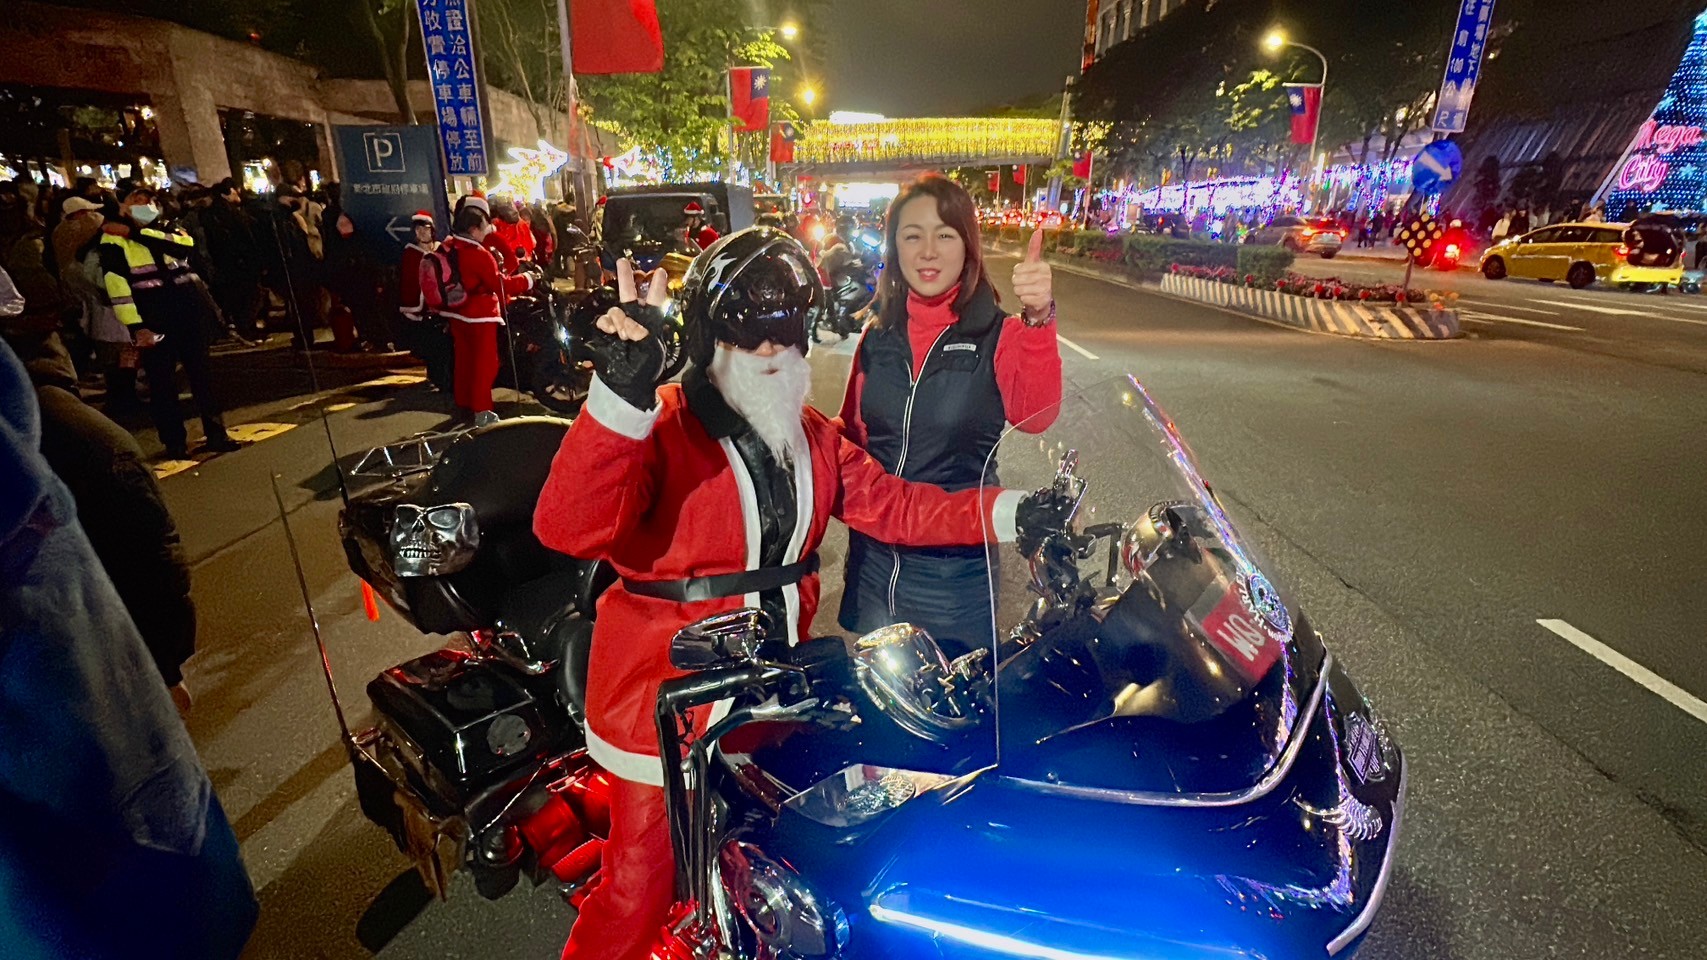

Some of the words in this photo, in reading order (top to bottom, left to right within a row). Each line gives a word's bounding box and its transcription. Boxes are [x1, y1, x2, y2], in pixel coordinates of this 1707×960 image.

[422, 0, 465, 172] 收費停車場停放
[445, 0, 483, 171] 證洽公車輛至前
[373, 137, 393, 168] P
[1634, 119, 1703, 154] Mega
[1619, 154, 1668, 191] City
